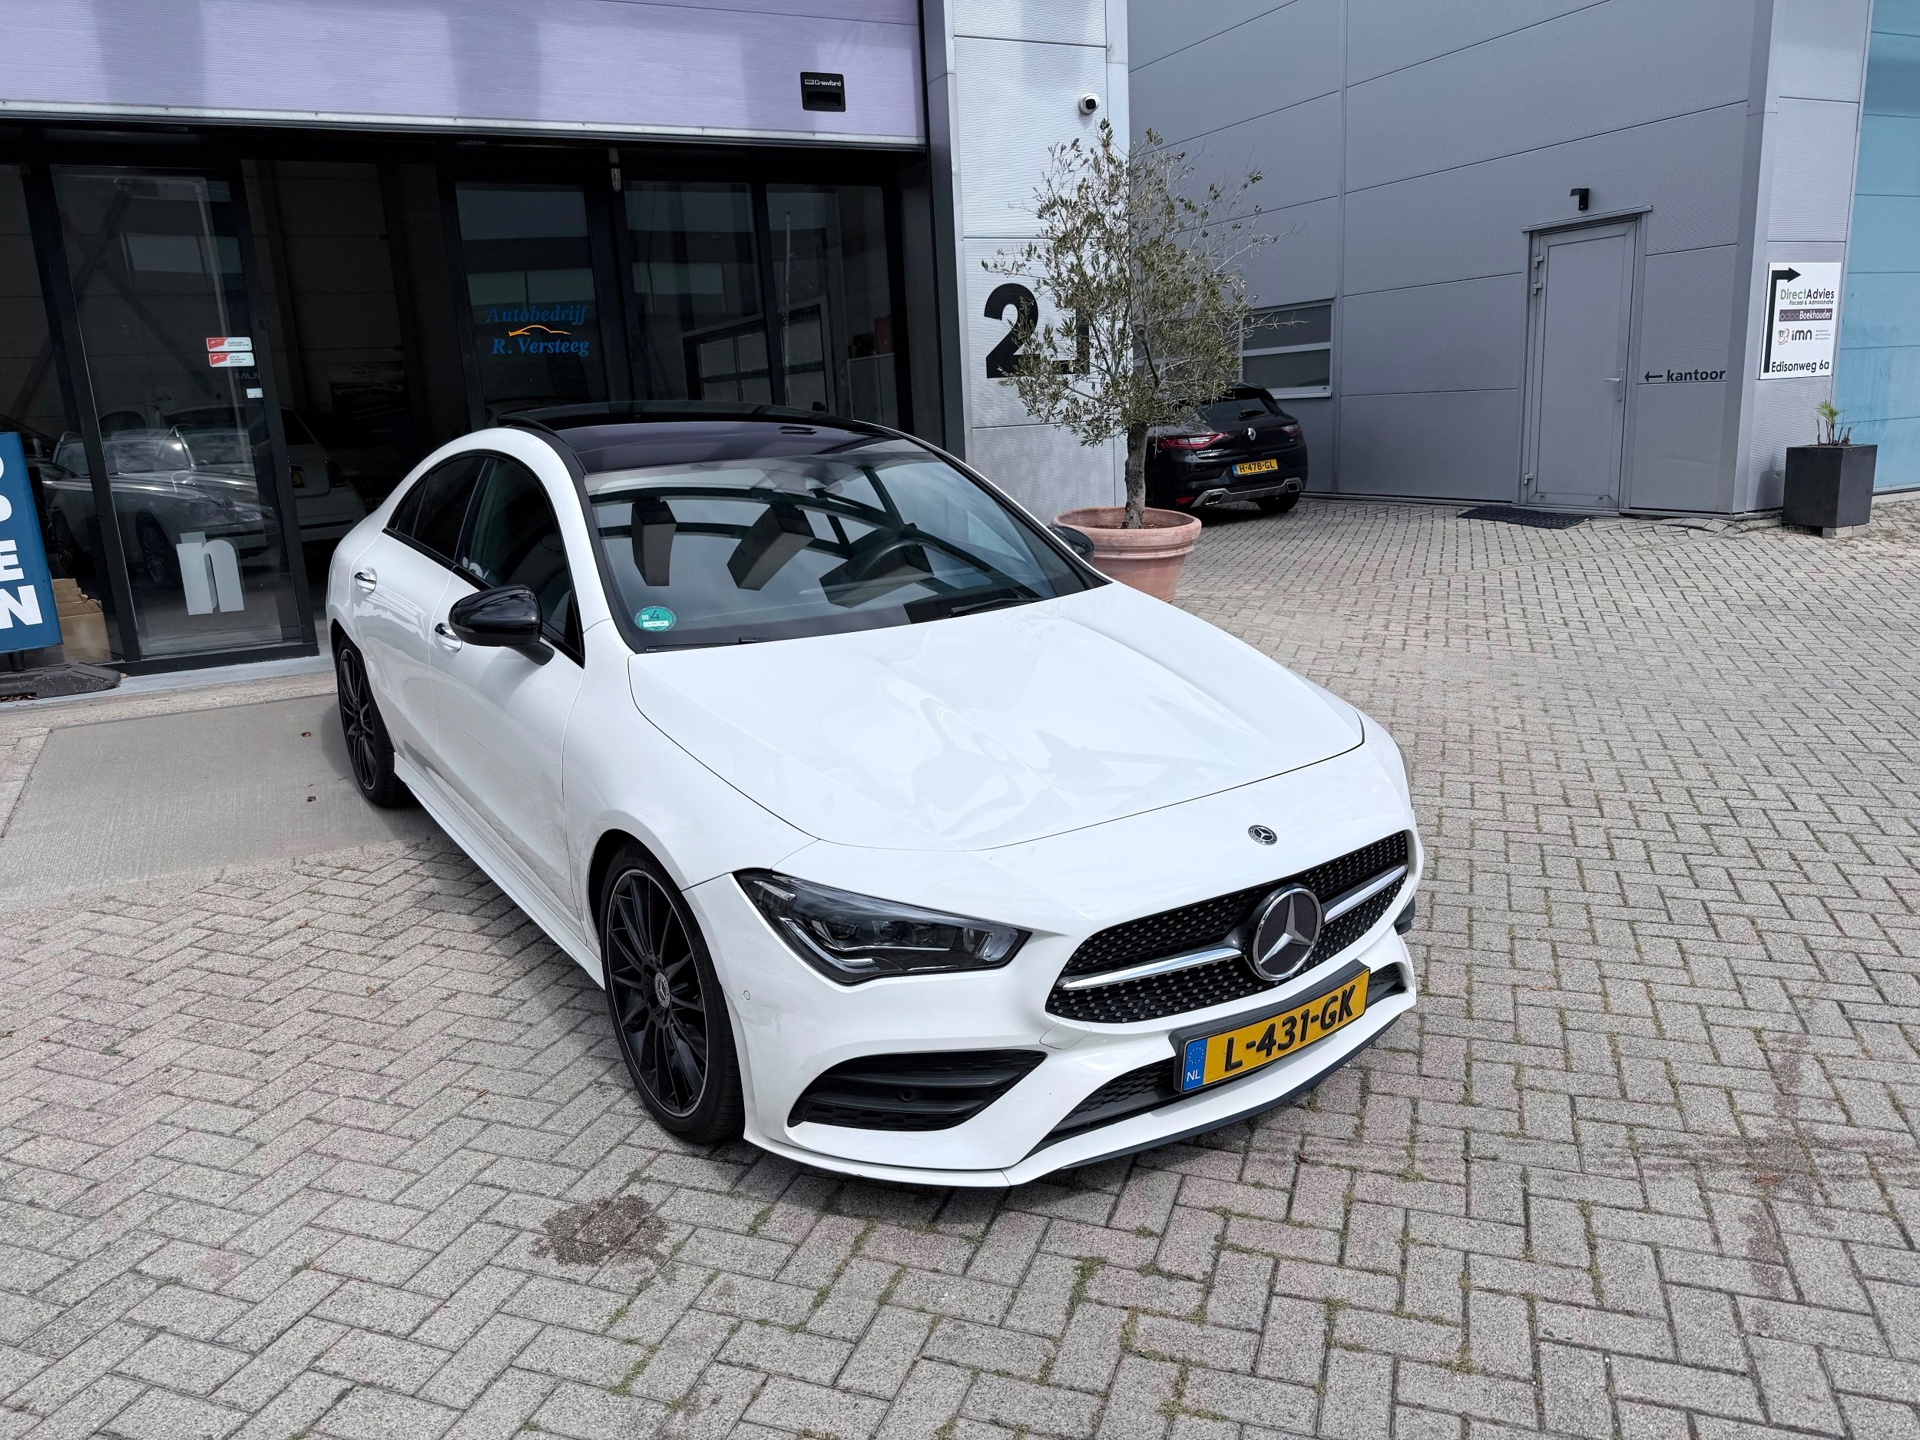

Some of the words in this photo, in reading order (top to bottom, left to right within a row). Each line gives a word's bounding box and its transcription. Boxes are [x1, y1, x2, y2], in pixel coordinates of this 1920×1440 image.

[1780, 288, 1835, 300] DirectAdvies
[486, 304, 589, 326] Autobedrijf
[1791, 329, 1812, 341] imn
[491, 338, 513, 355] R.
[517, 338, 590, 357] Versteeg
[1771, 361, 1817, 373] Edisonweg
[1818, 359, 1830, 370] 6a
[1666, 369, 1727, 382] kantoor
[1238, 460, 1275, 474] H-478-GL
[650, 609, 661, 620] 4
[1224, 984, 1356, 1073] L-431-GK
[1186, 1069, 1202, 1083] NL
